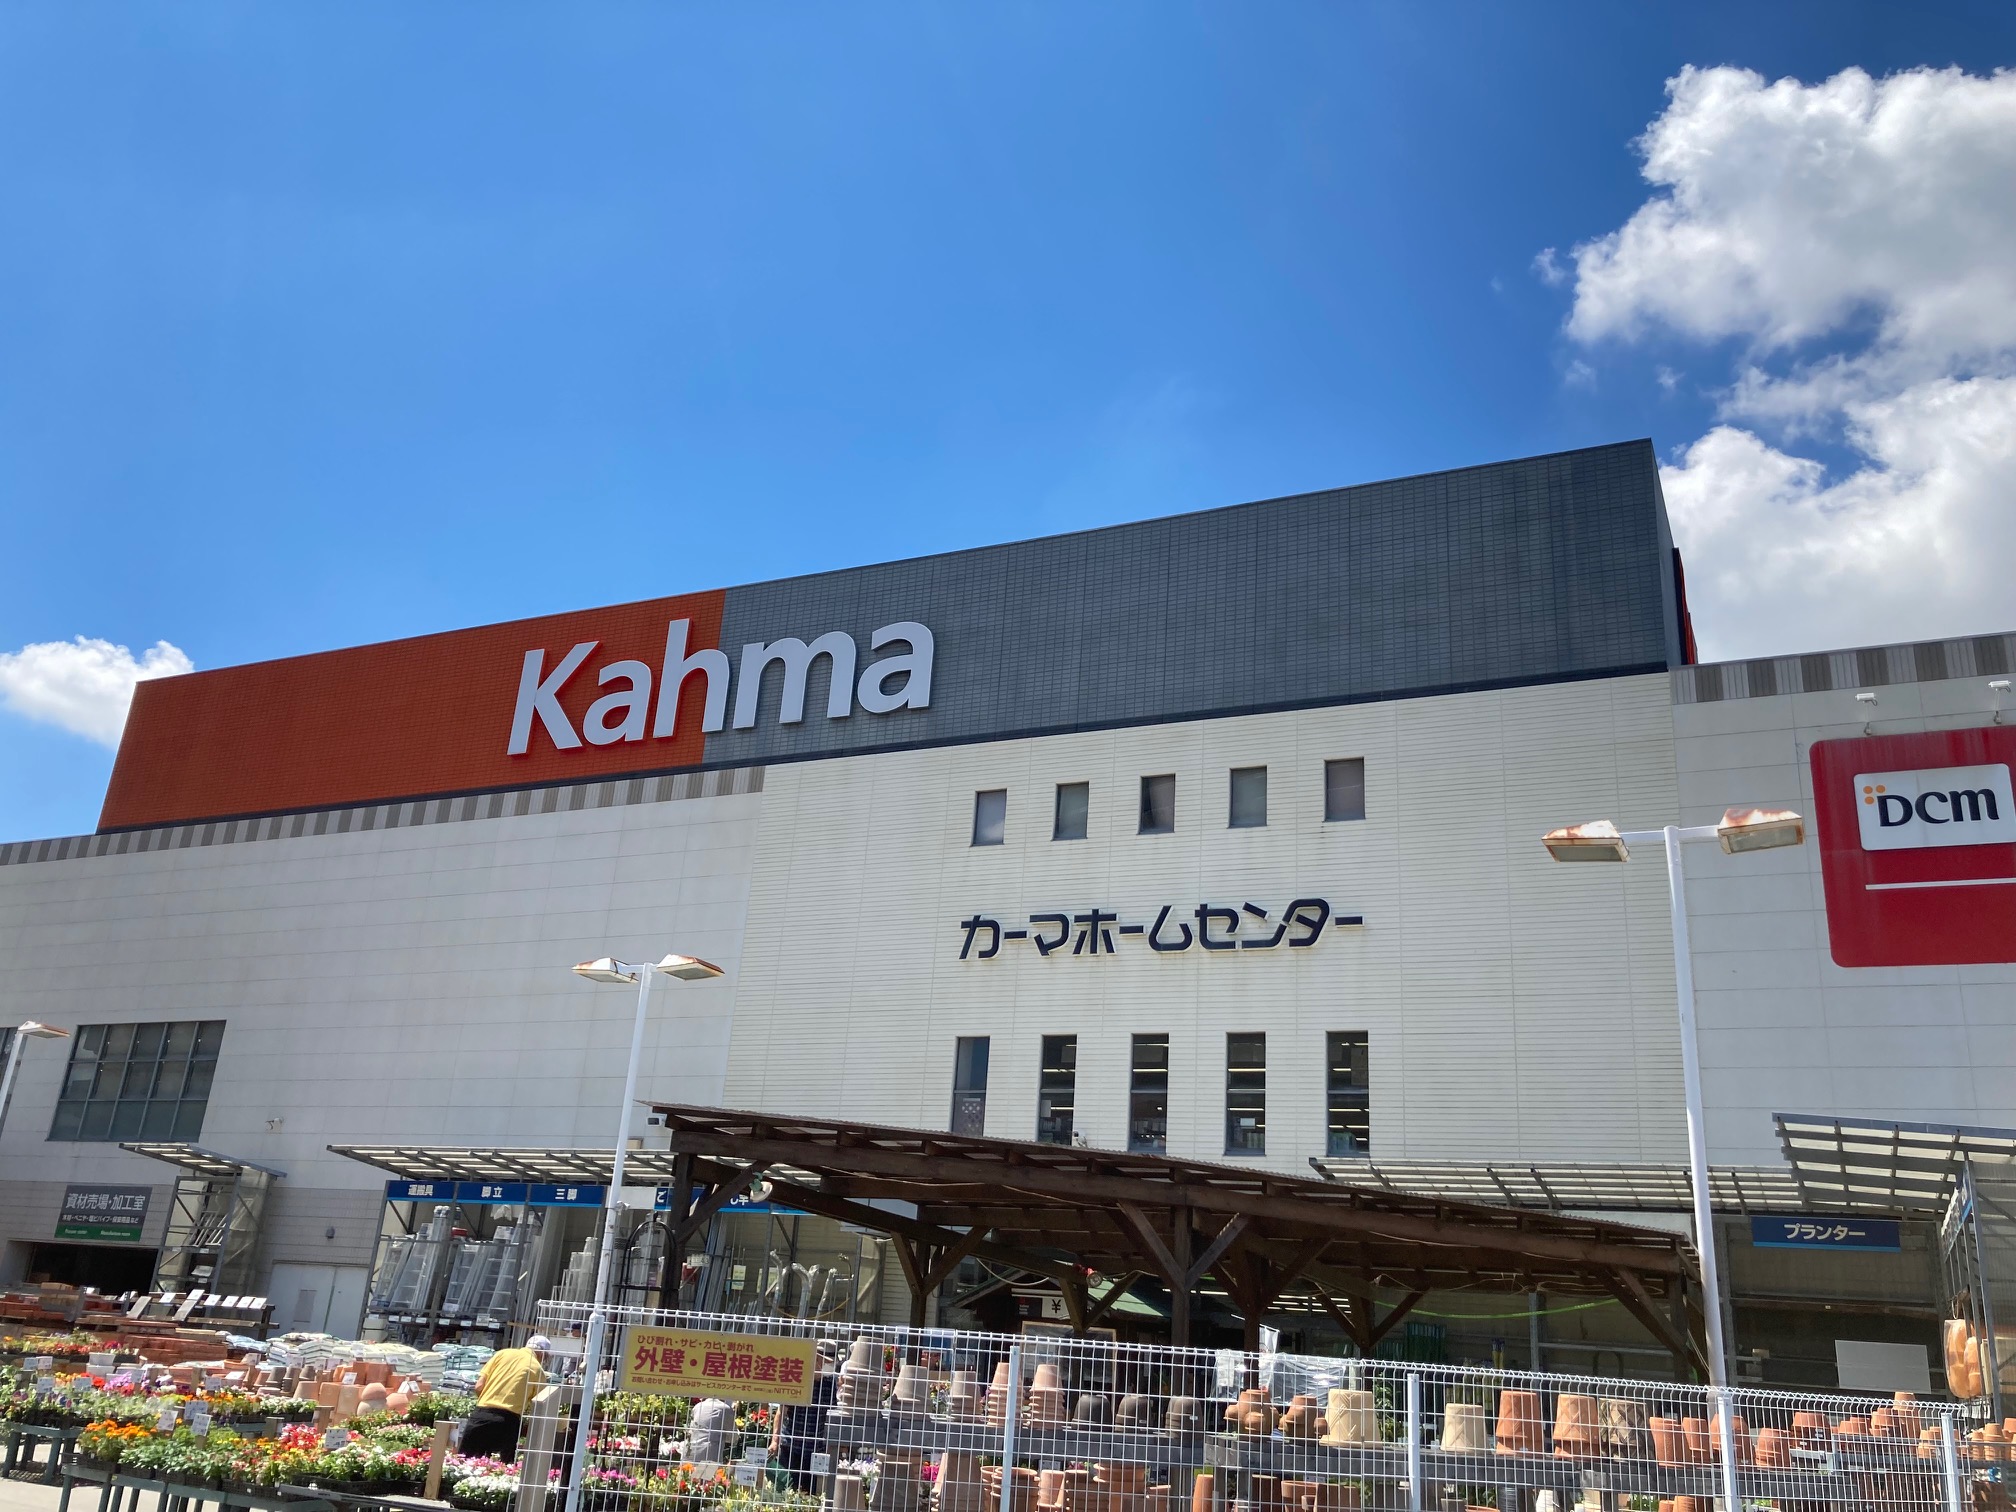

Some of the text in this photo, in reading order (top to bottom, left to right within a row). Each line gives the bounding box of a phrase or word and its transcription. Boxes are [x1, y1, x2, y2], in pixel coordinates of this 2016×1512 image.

[507, 618, 934, 755] Kahma
[959, 898, 1364, 960] カーマホームセンター
[481, 1186, 503, 1199] 脚立
[555, 1188, 577, 1201] 三脚
[1783, 1222, 1866, 1241] プランター
[634, 1346, 805, 1384] 外壁・屋根塗装
[774, 1387, 802, 1396] NITTOH
